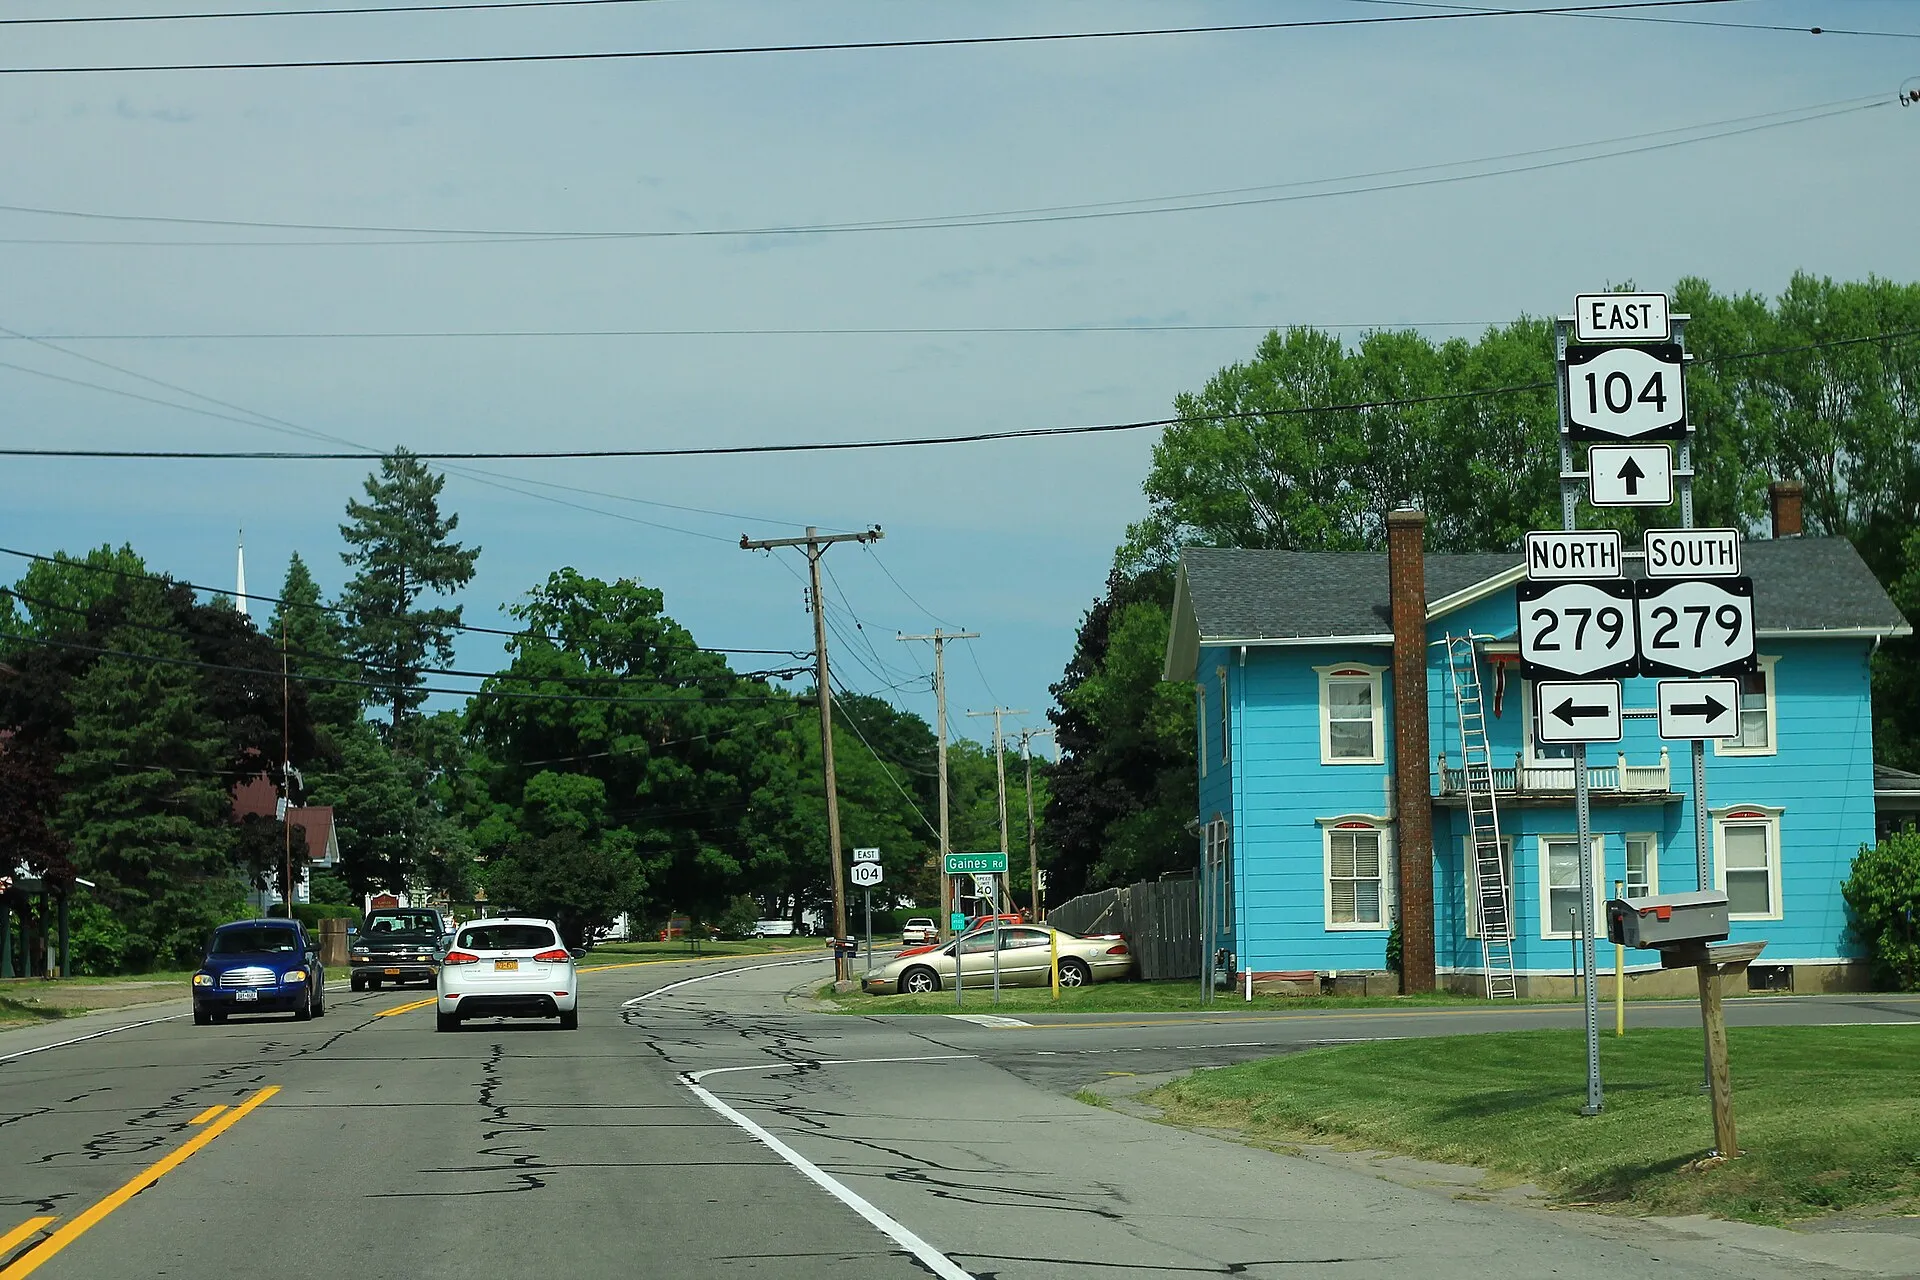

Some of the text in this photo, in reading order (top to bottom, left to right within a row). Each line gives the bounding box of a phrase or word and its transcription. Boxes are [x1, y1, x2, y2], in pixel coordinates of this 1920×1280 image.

[1592, 302, 1652, 330] EAST
[1584, 371, 1667, 415] 104
[1532, 540, 1616, 569] NORTH
[1652, 538, 1734, 567] SOUTH
[1531, 606, 1624, 651] 279
[1650, 604, 1742, 649] 279
[857, 850, 875, 859] EAST
[949, 857, 1003, 869] Gaines Rd
[855, 867, 879, 881] 104
[976, 885, 992, 895] 40
